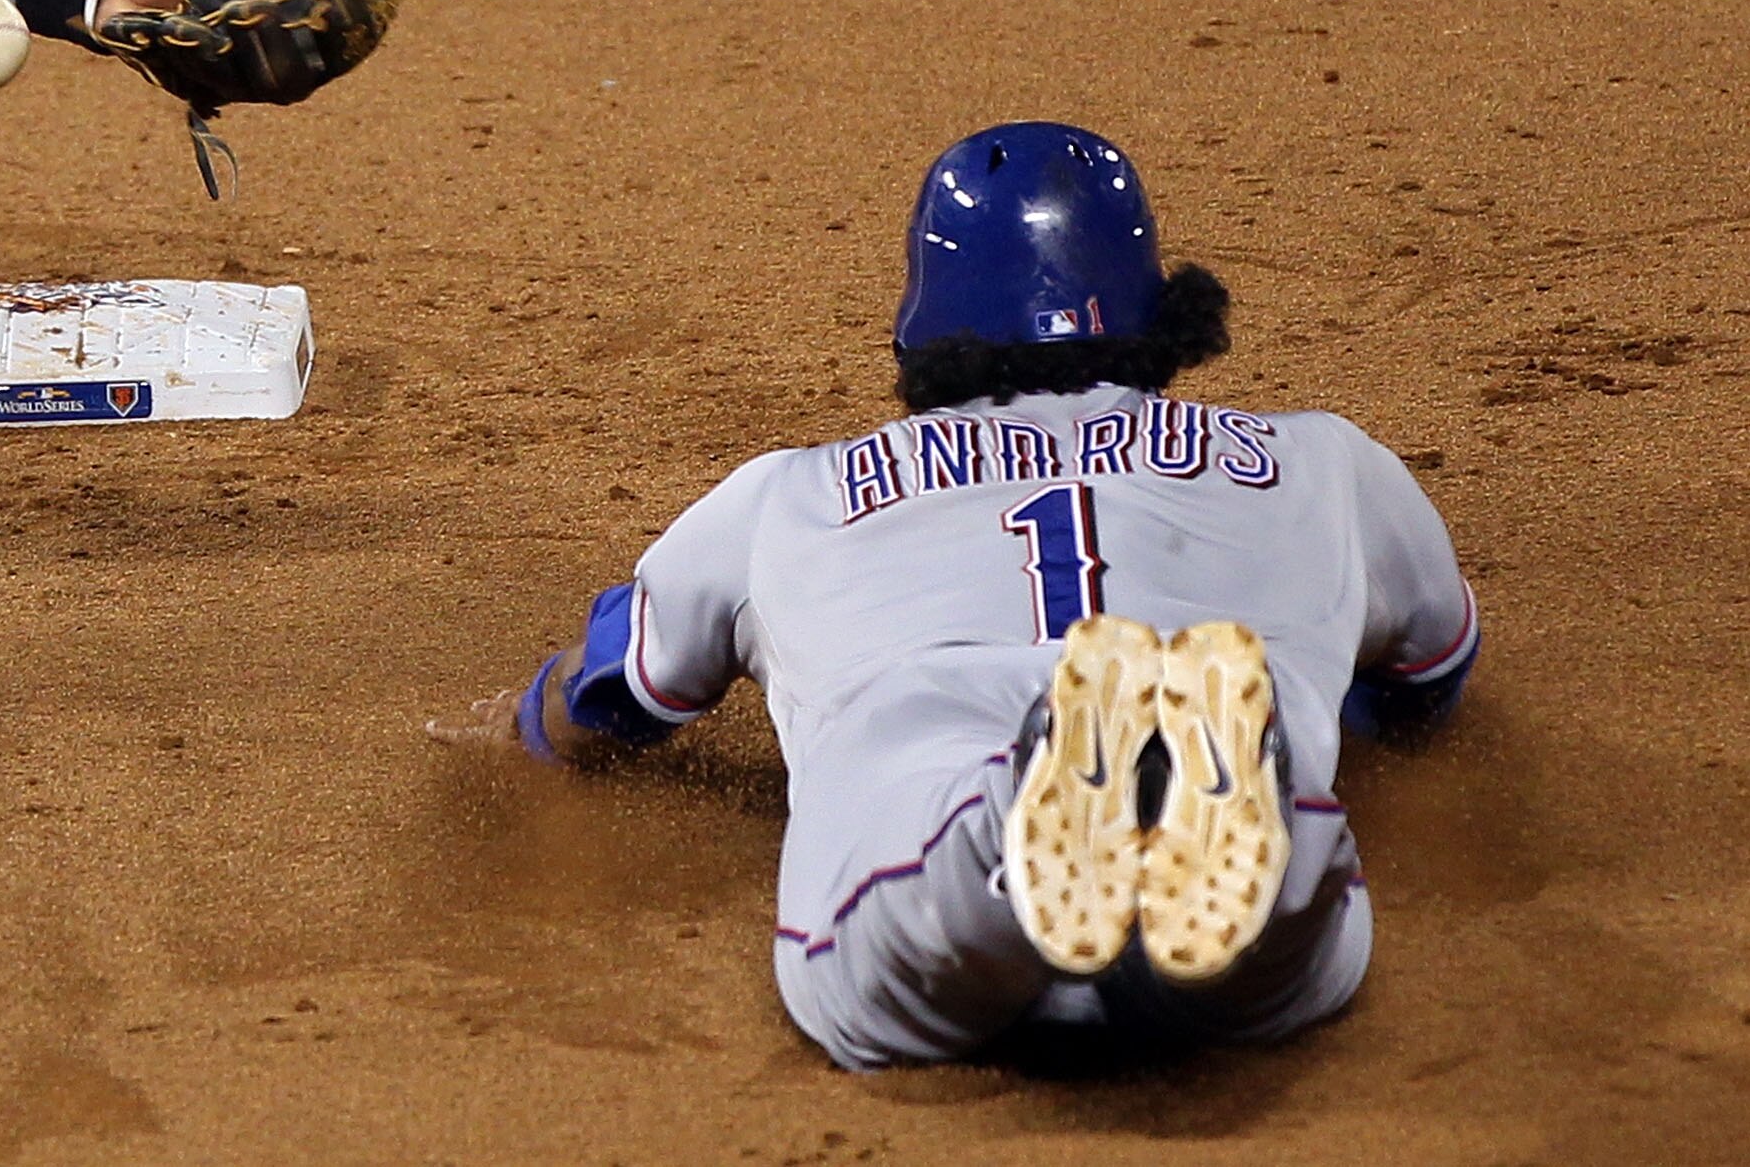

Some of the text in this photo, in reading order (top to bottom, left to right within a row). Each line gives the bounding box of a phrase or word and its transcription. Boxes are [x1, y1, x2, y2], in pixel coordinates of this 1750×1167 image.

[1086, 295, 1104, 335] 1
[838, 396, 1281, 526] ANDRUS
[1001, 480, 1109, 645] 1
